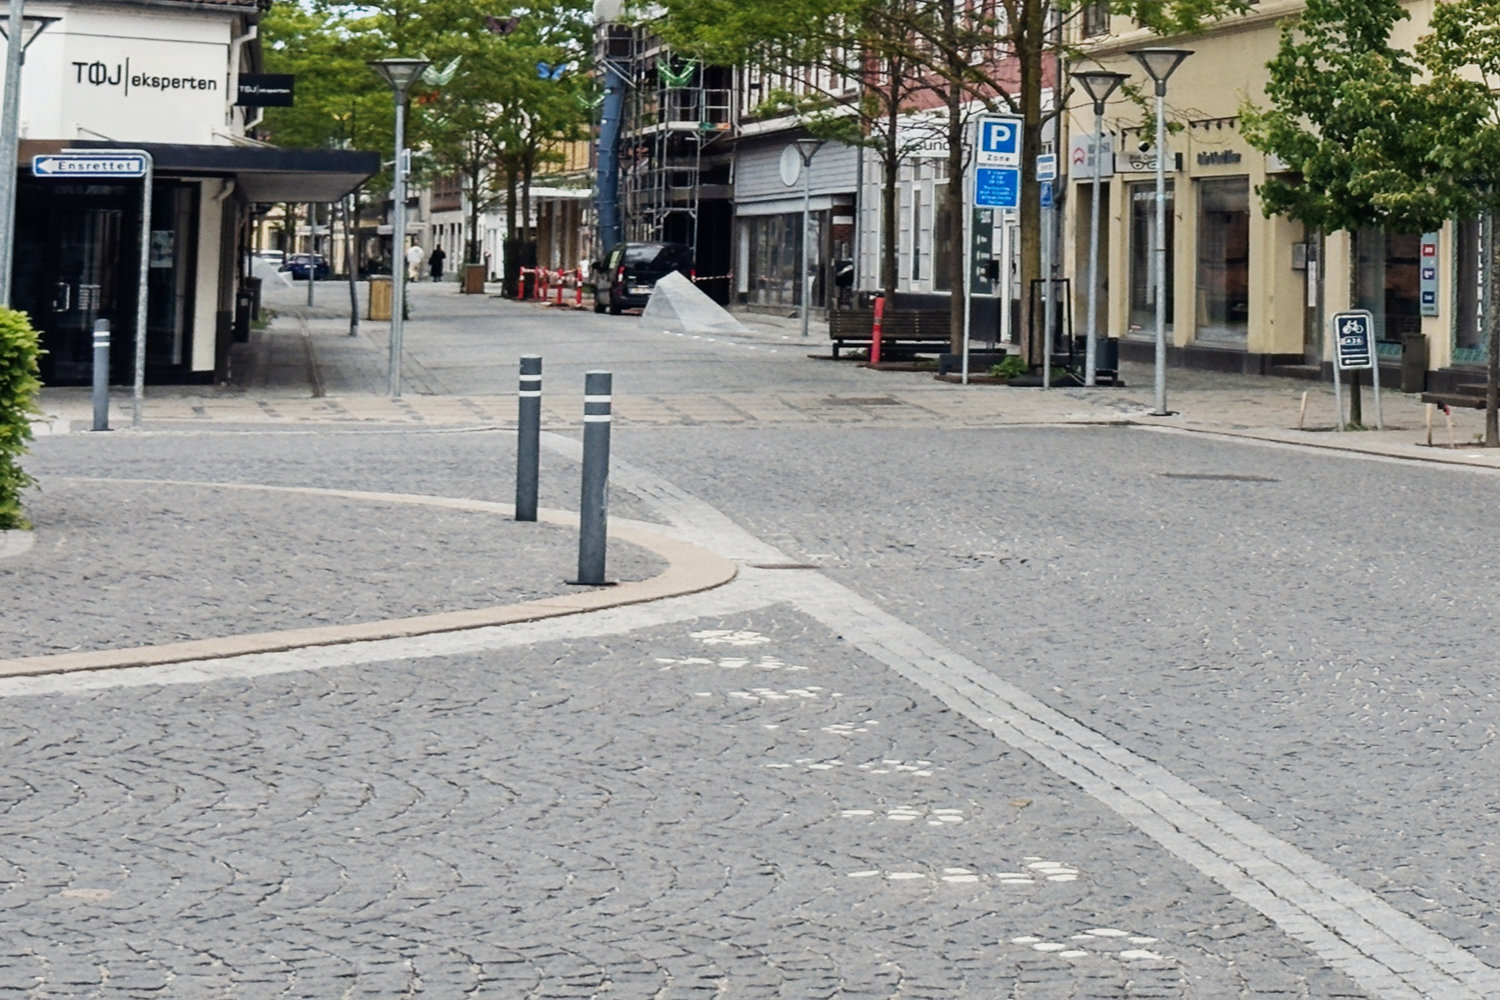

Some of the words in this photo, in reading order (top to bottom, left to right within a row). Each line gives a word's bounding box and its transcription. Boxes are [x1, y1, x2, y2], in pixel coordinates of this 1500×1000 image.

[72, 60, 122, 87] TØJ
[131, 72, 217, 91] eksperten
[990, 124, 1011, 150] P
[58, 161, 132, 170] Ensrettet
[987, 154, 1010, 162] Zone
